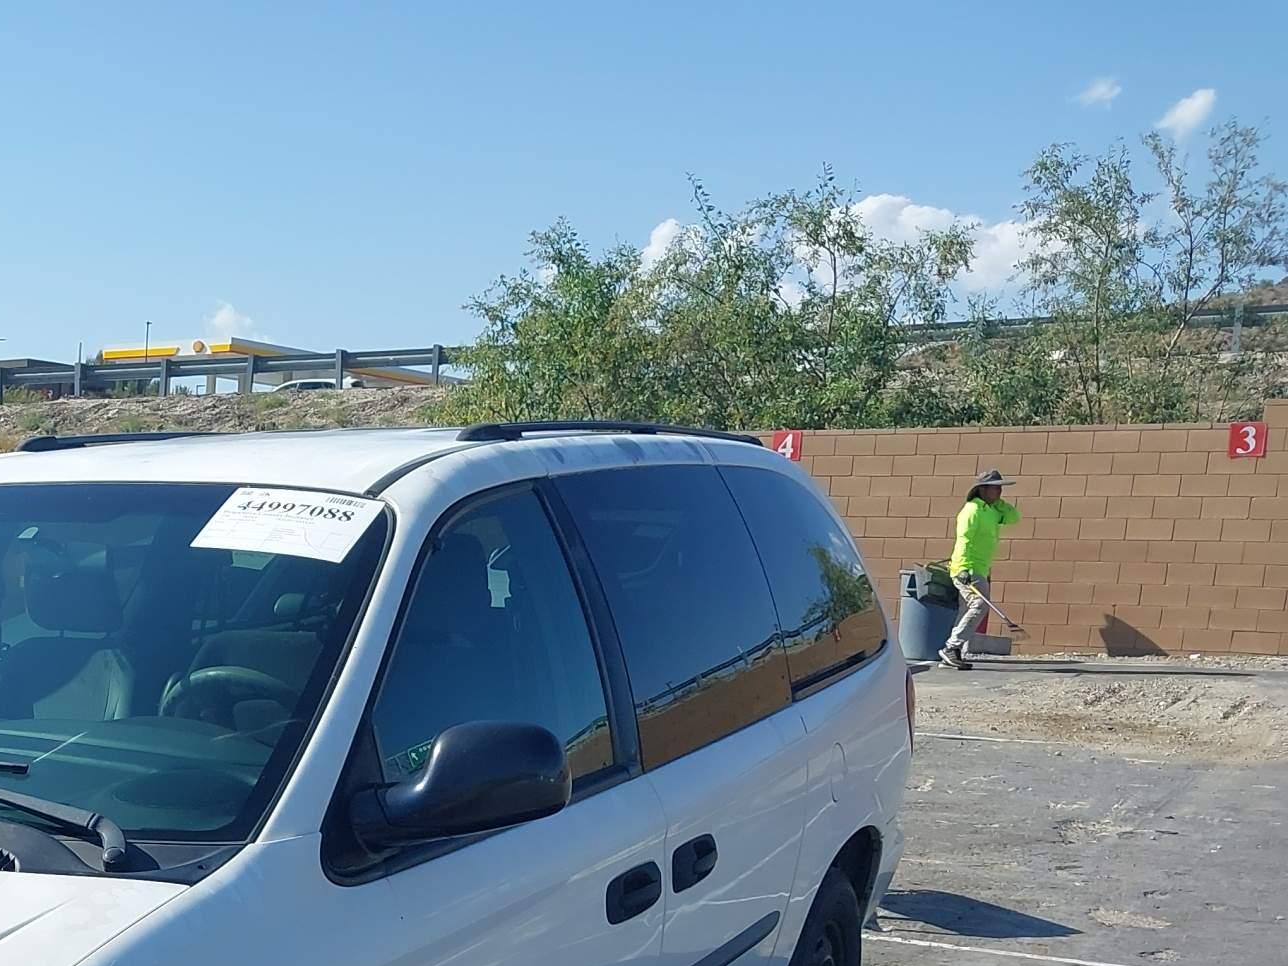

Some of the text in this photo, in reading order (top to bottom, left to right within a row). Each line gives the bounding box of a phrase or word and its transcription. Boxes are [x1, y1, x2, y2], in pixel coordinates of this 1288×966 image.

[777, 433, 794, 459] 4
[1235, 425, 1257, 454] 3
[237, 499, 356, 523] 44997088
